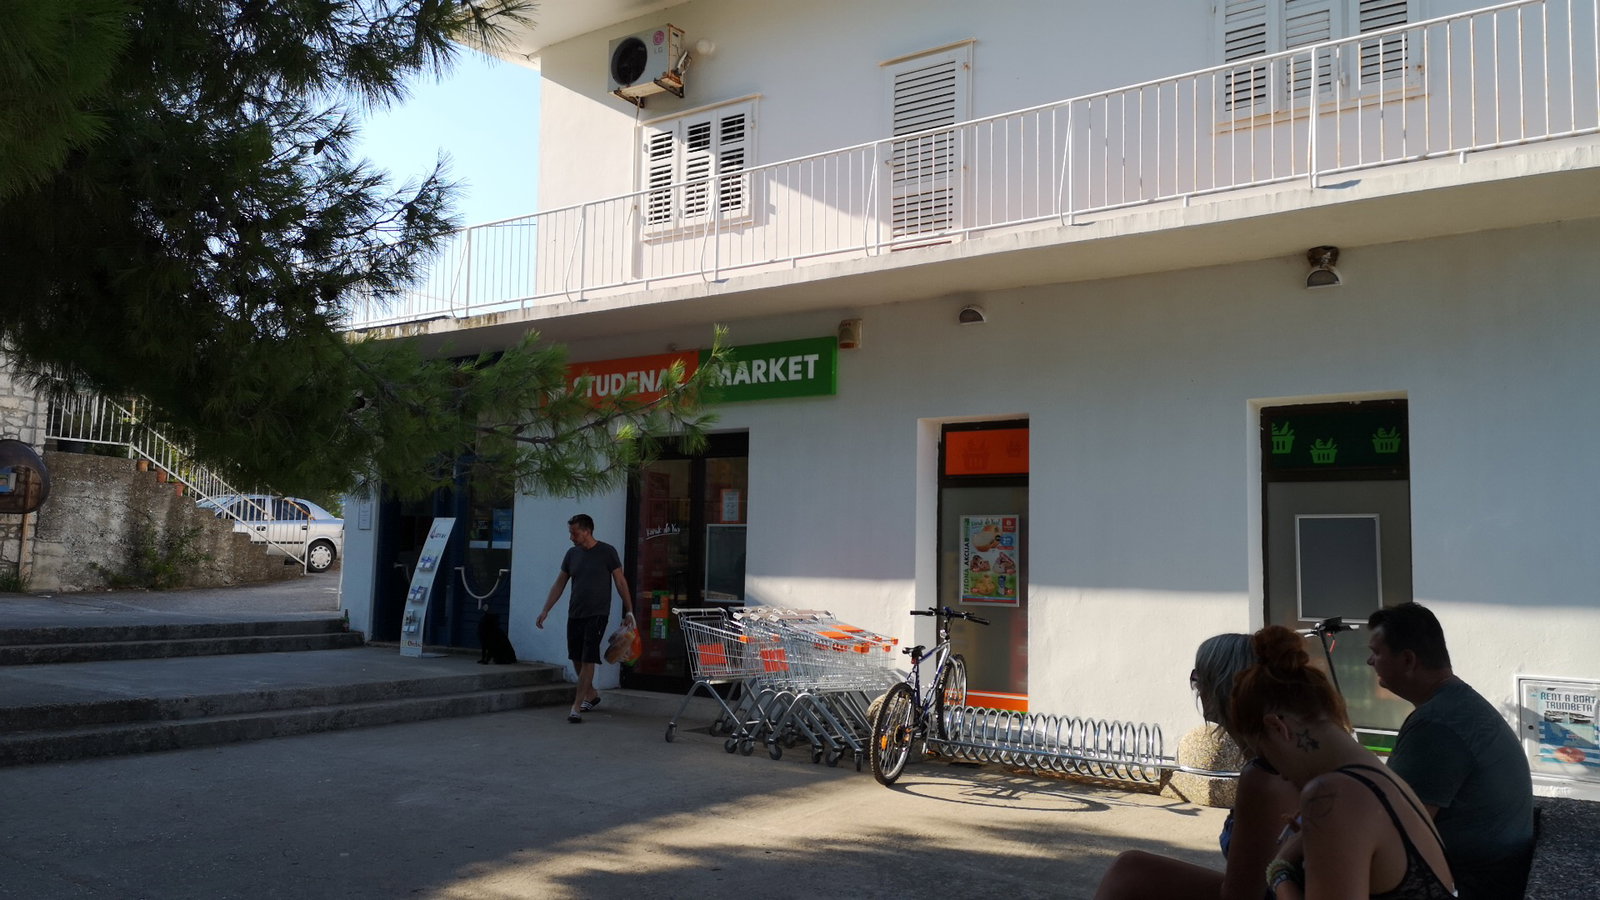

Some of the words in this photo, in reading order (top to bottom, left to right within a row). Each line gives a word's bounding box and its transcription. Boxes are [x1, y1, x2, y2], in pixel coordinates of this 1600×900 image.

[708, 354, 819, 387] MARKET
[1540, 692, 1563, 701] RENT
[1565, 694, 1571, 702] A
[1573, 694, 1597, 704] BOAT
[1545, 701, 1593, 712] TRUMBETA
